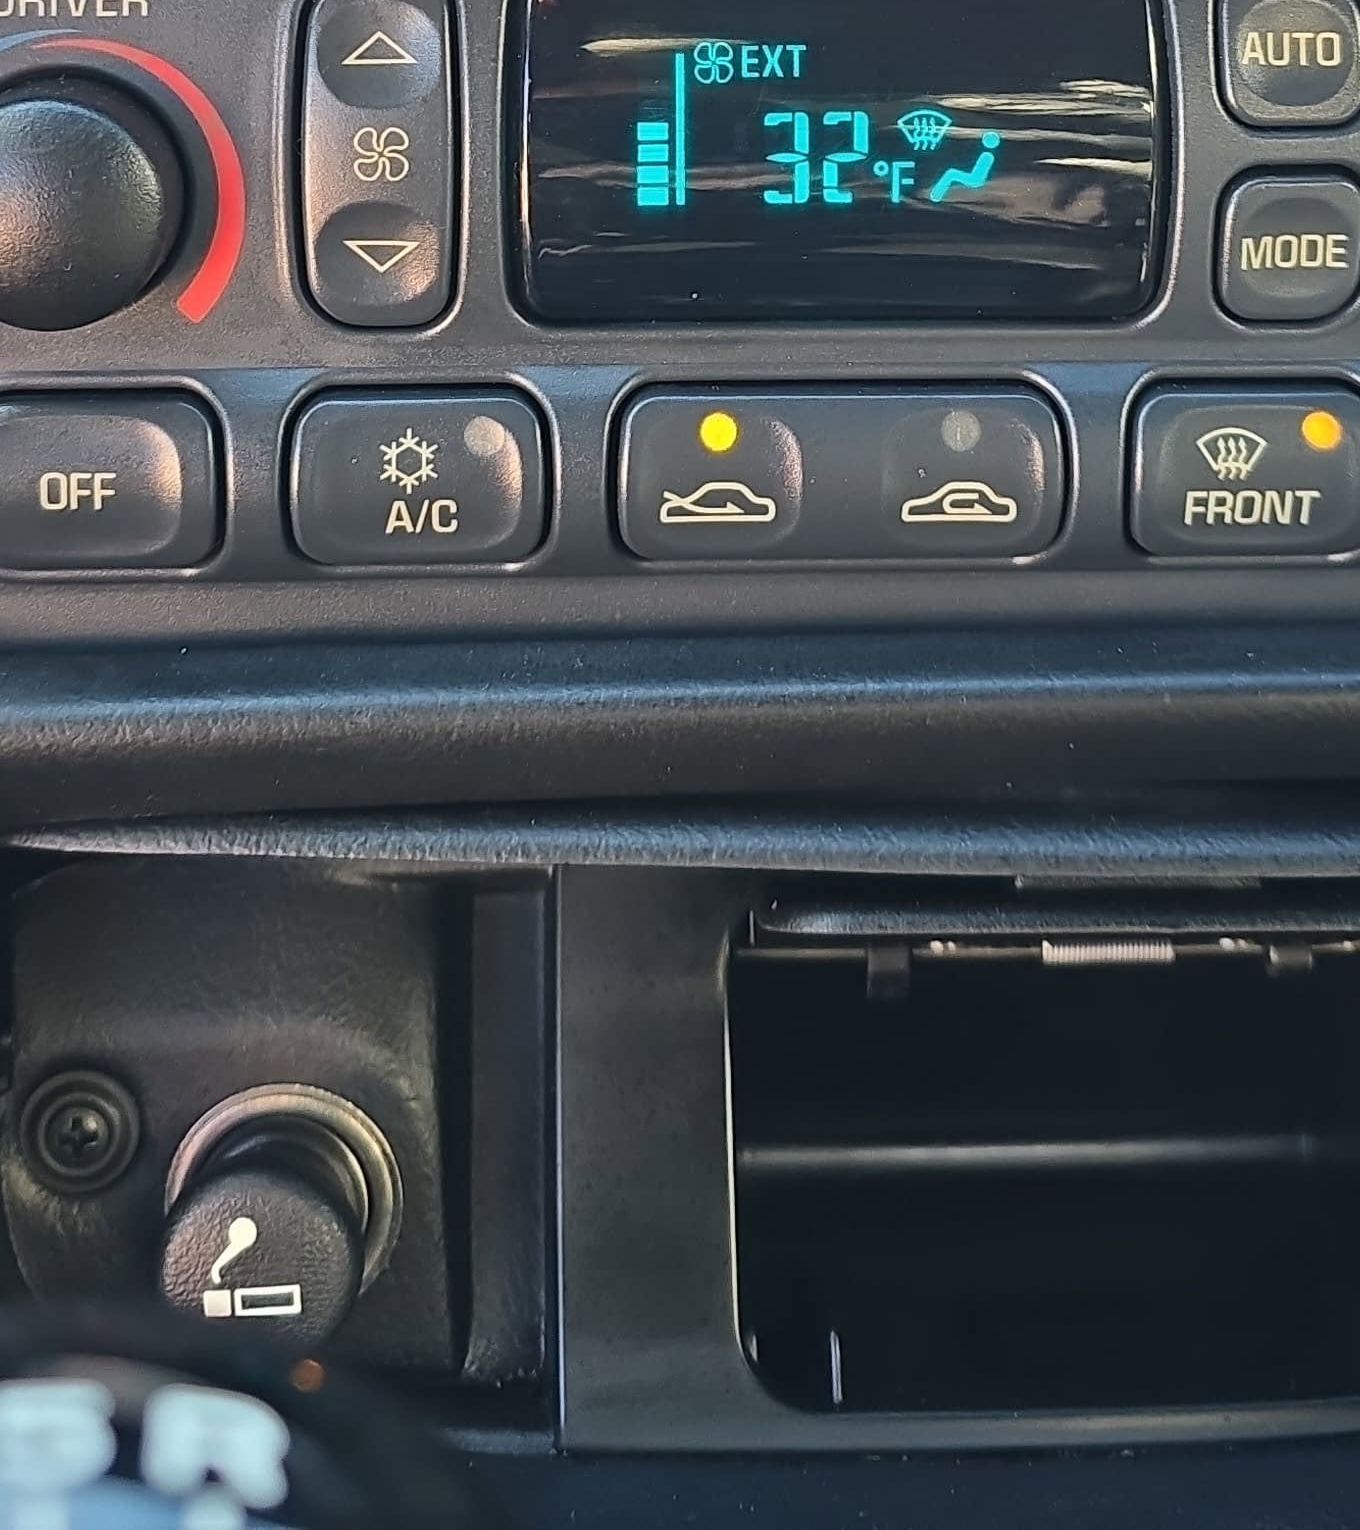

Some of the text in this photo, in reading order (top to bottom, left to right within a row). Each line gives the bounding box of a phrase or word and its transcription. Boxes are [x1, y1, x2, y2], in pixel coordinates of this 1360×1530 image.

[741, 44, 807, 78] EXT
[1240, 30, 1341, 68] AUTO
[763, 110, 870, 204] 32
[1240, 233, 1349, 271] MODE
[39, 471, 117, 511] OFF
[1183, 488, 1320, 526] FRONT
[385, 498, 459, 535] A/C
